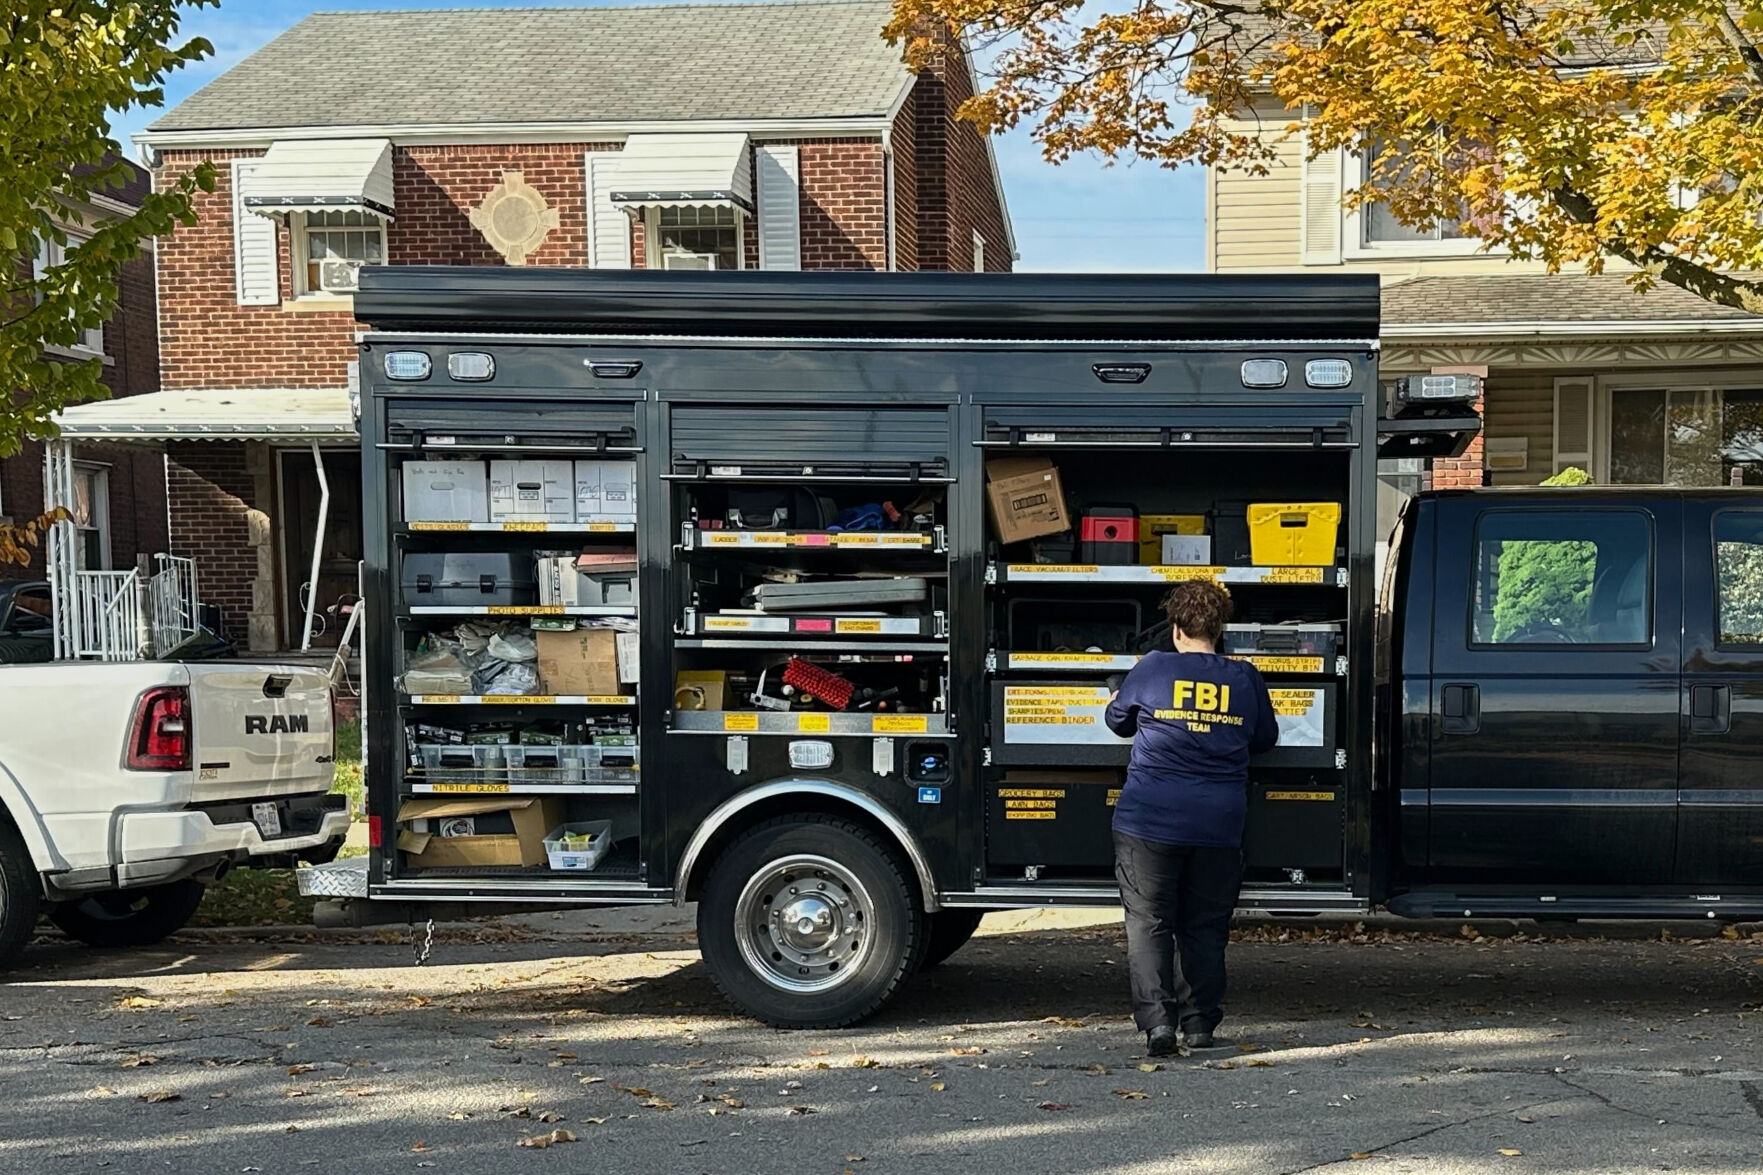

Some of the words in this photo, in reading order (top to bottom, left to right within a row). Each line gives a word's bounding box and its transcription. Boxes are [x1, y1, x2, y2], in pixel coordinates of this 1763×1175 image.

[1271, 567, 1298, 575] LARGE
[1260, 575, 1282, 583] DUST
[1288, 575, 1322, 583] LIFTER
[488, 606, 516, 614] PHOTO
[521, 606, 565, 614] SUPPLIES
[1173, 679, 1230, 713] FBI
[1290, 699, 1314, 707] BAGS
[1006, 716, 1058, 724] REFERENCE
[1153, 709, 1199, 720] EVIDENCE
[1200, 712, 1244, 726] RESPONSE
[245, 714, 309, 734] RAM
[1186, 722, 1211, 733] TEAM
[432, 784, 473, 793] NITRILE
[475, 785, 509, 793] GLOVES
[1006, 800, 1028, 808] LAWN
[1033, 800, 1055, 808] BAGS
